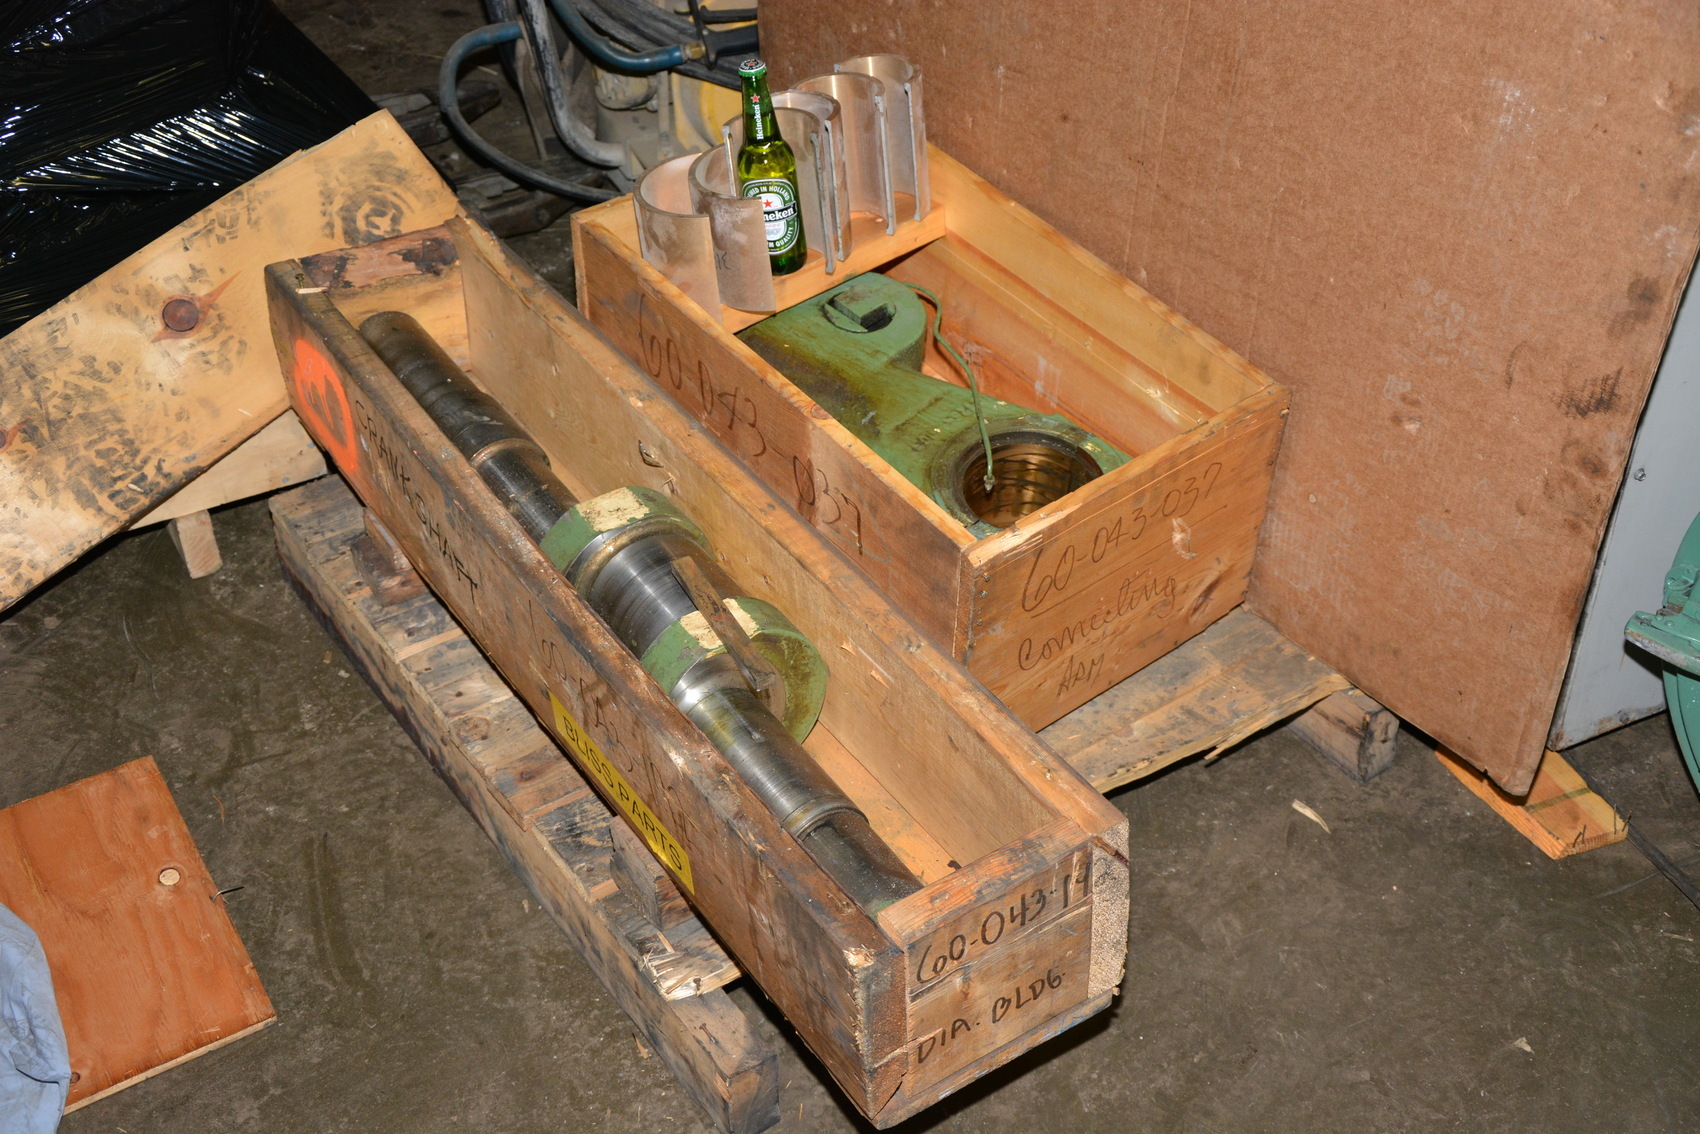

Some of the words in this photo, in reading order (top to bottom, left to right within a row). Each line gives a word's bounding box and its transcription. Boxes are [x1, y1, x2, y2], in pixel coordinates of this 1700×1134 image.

[754, 104, 764, 140] Heineken
[759, 185, 768, 193] IN
[768, 185, 790, 201] HOLLAND
[764, 206, 794, 221] neken
[775, 226, 794, 247] QUALITY
[1021, 462, 1222, 613] 60-043-037
[562, 715, 614, 788] BLISS
[618, 780, 682, 871] PARTS
[917, 1018, 981, 1064] DIA.
